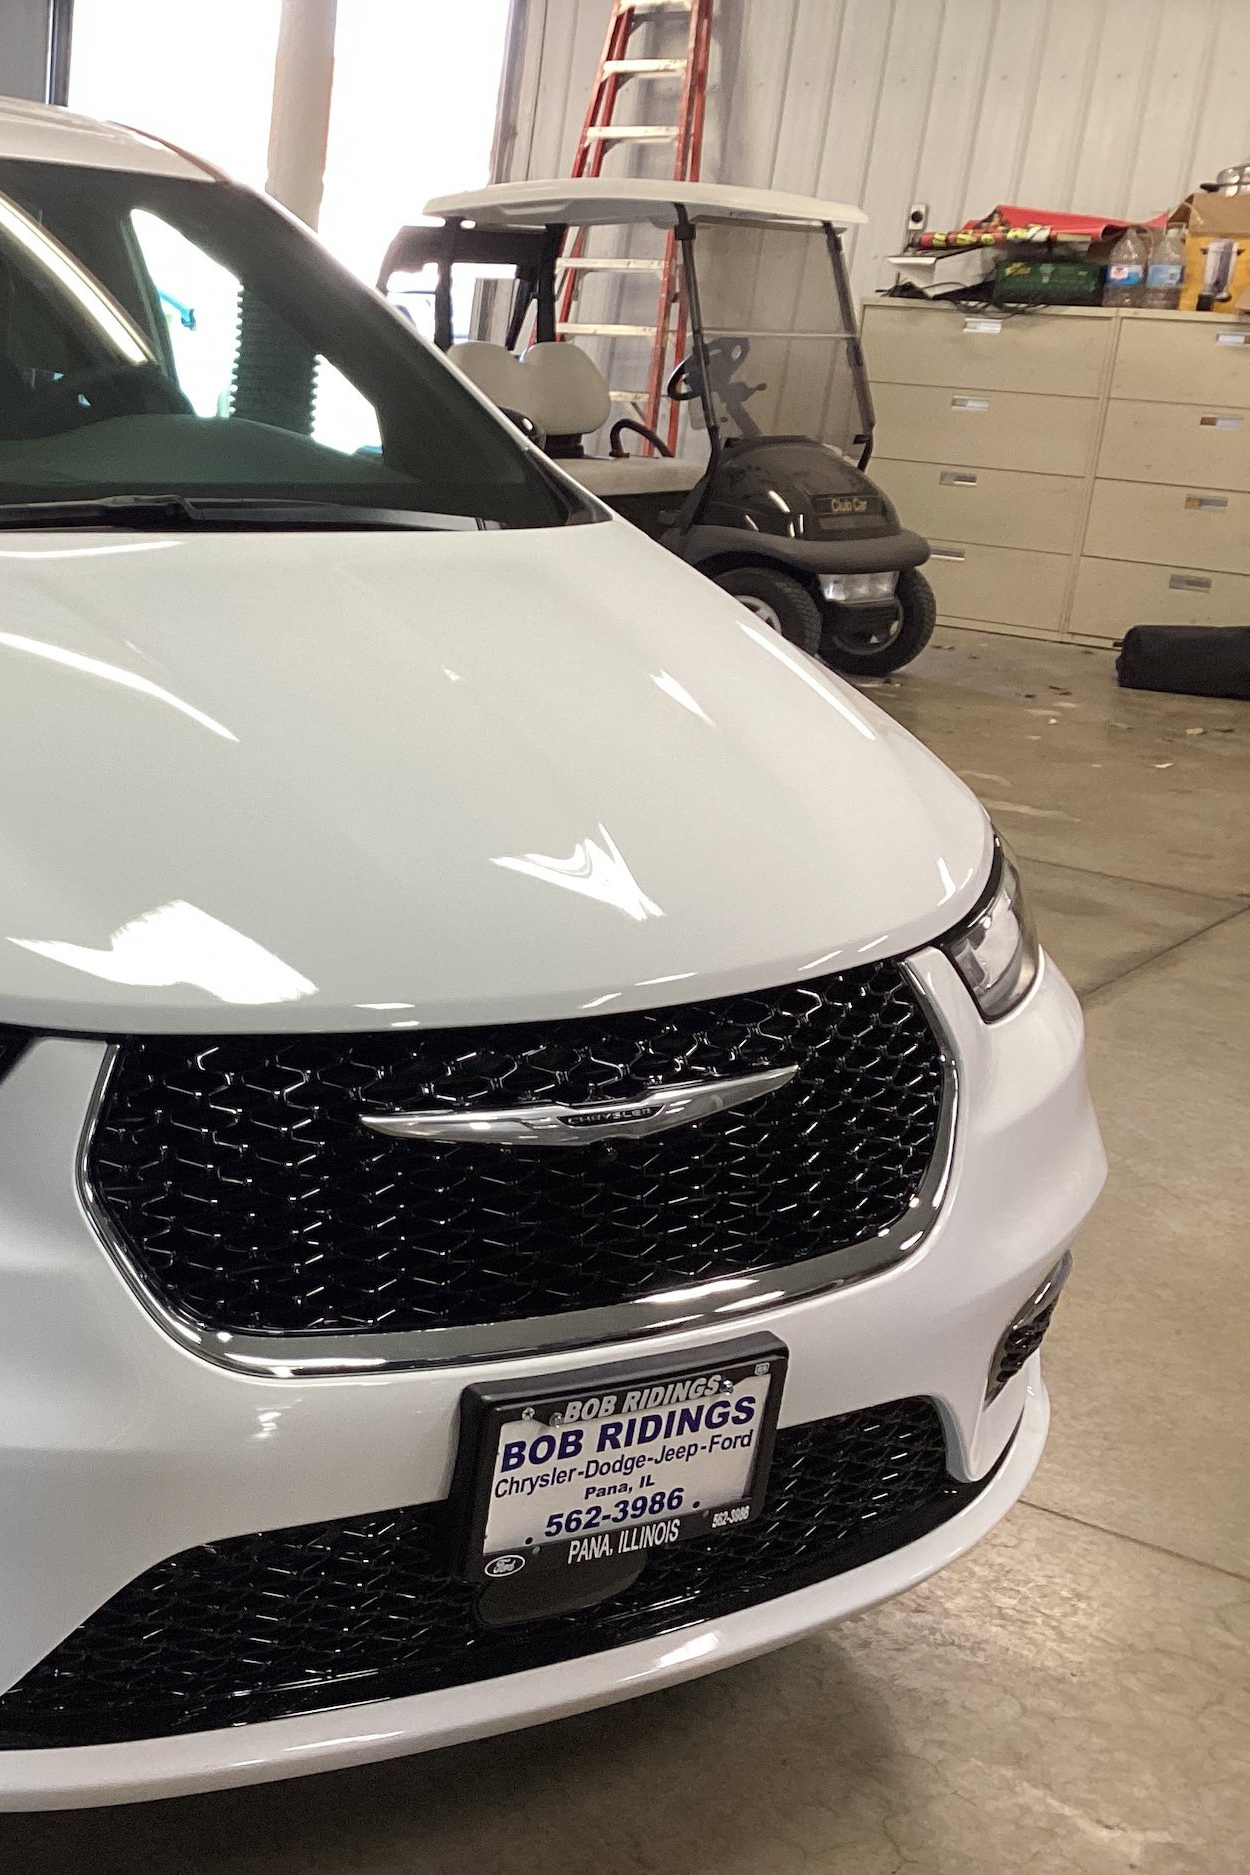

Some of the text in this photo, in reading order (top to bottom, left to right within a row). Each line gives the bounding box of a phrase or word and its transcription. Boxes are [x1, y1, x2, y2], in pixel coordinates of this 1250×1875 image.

[567, 1108, 651, 1124] CHRYSLER
[563, 1374, 722, 1424] BOB RIDINGS
[500, 1396, 756, 1473] BOB RIDINGS
[494, 1429, 754, 1499] Chrysler-Dodge-Jeep-Ford
[584, 1474, 655, 1500] Pana, IL
[544, 1487, 685, 1537] 562-3986
[567, 1518, 681, 1565] PANA, ILLINOIS
